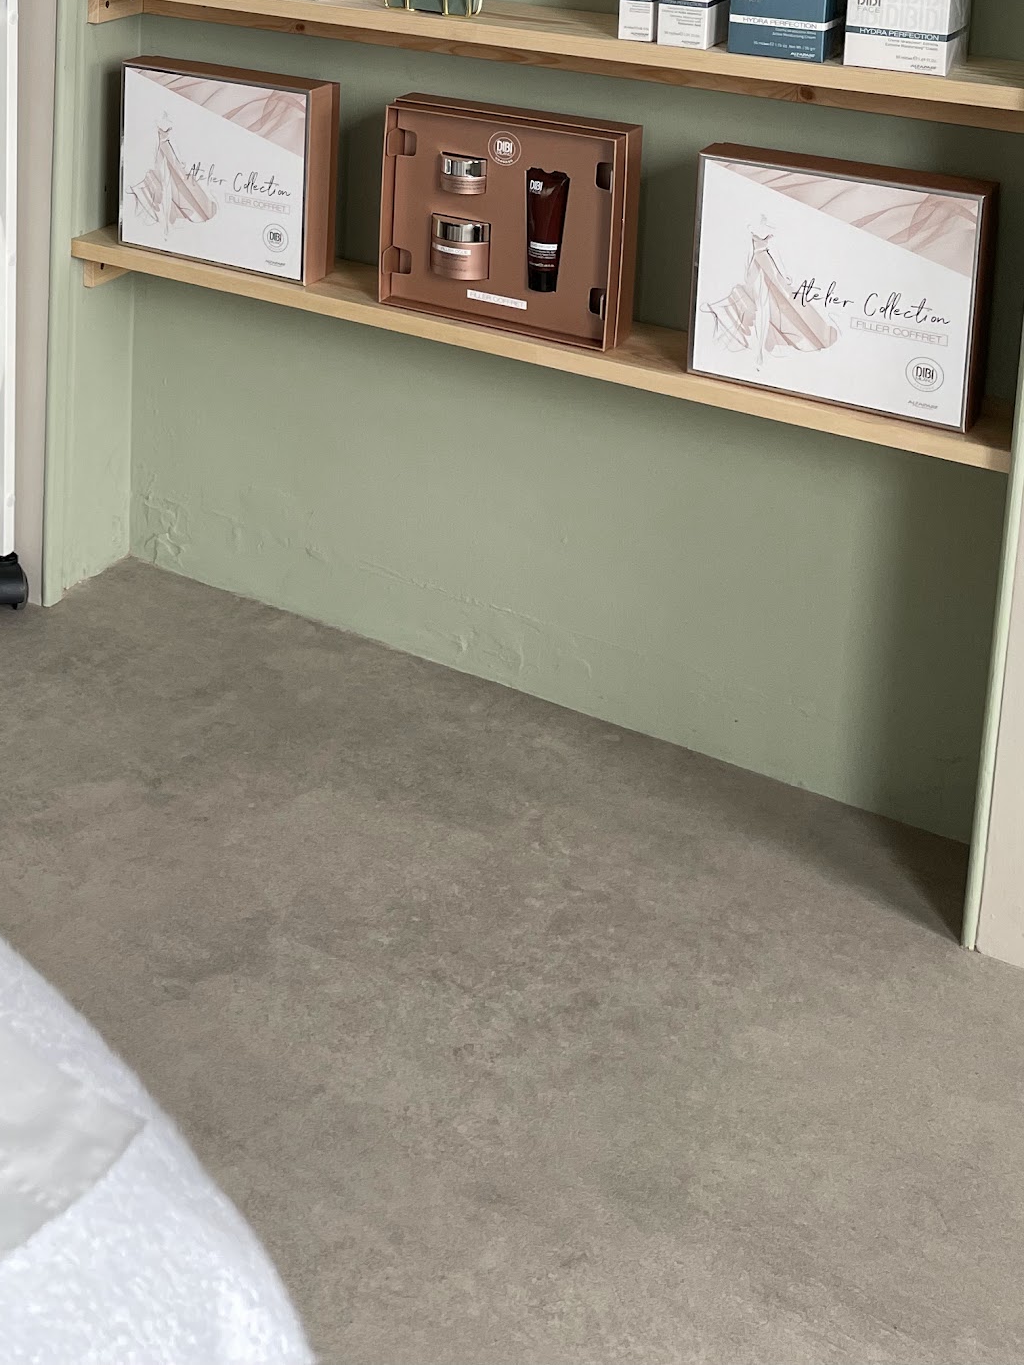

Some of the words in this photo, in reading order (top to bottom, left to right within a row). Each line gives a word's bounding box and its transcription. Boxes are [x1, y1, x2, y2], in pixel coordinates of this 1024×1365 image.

[742, 17, 768, 25] HYDRA
[769, 19, 817, 29] PERFECTION
[859, 28, 888, 36] HYDRA
[888, 30, 940, 41] PERFECTION
[496, 139, 513, 154] DIBI
[185, 162, 227, 186] Atelier
[233, 171, 291, 197] Collection
[529, 180, 544, 191] DIBI
[229, 196, 252, 206] FILLER
[253, 200, 286, 213] COFFRET
[269, 231, 282, 242] DIBI
[791, 278, 854, 308] Atelier
[863, 291, 951, 325] Collection
[856, 320, 890, 333] FILLER
[892, 326, 943, 344] COFFRET
[916, 366, 934, 380] DIBI
